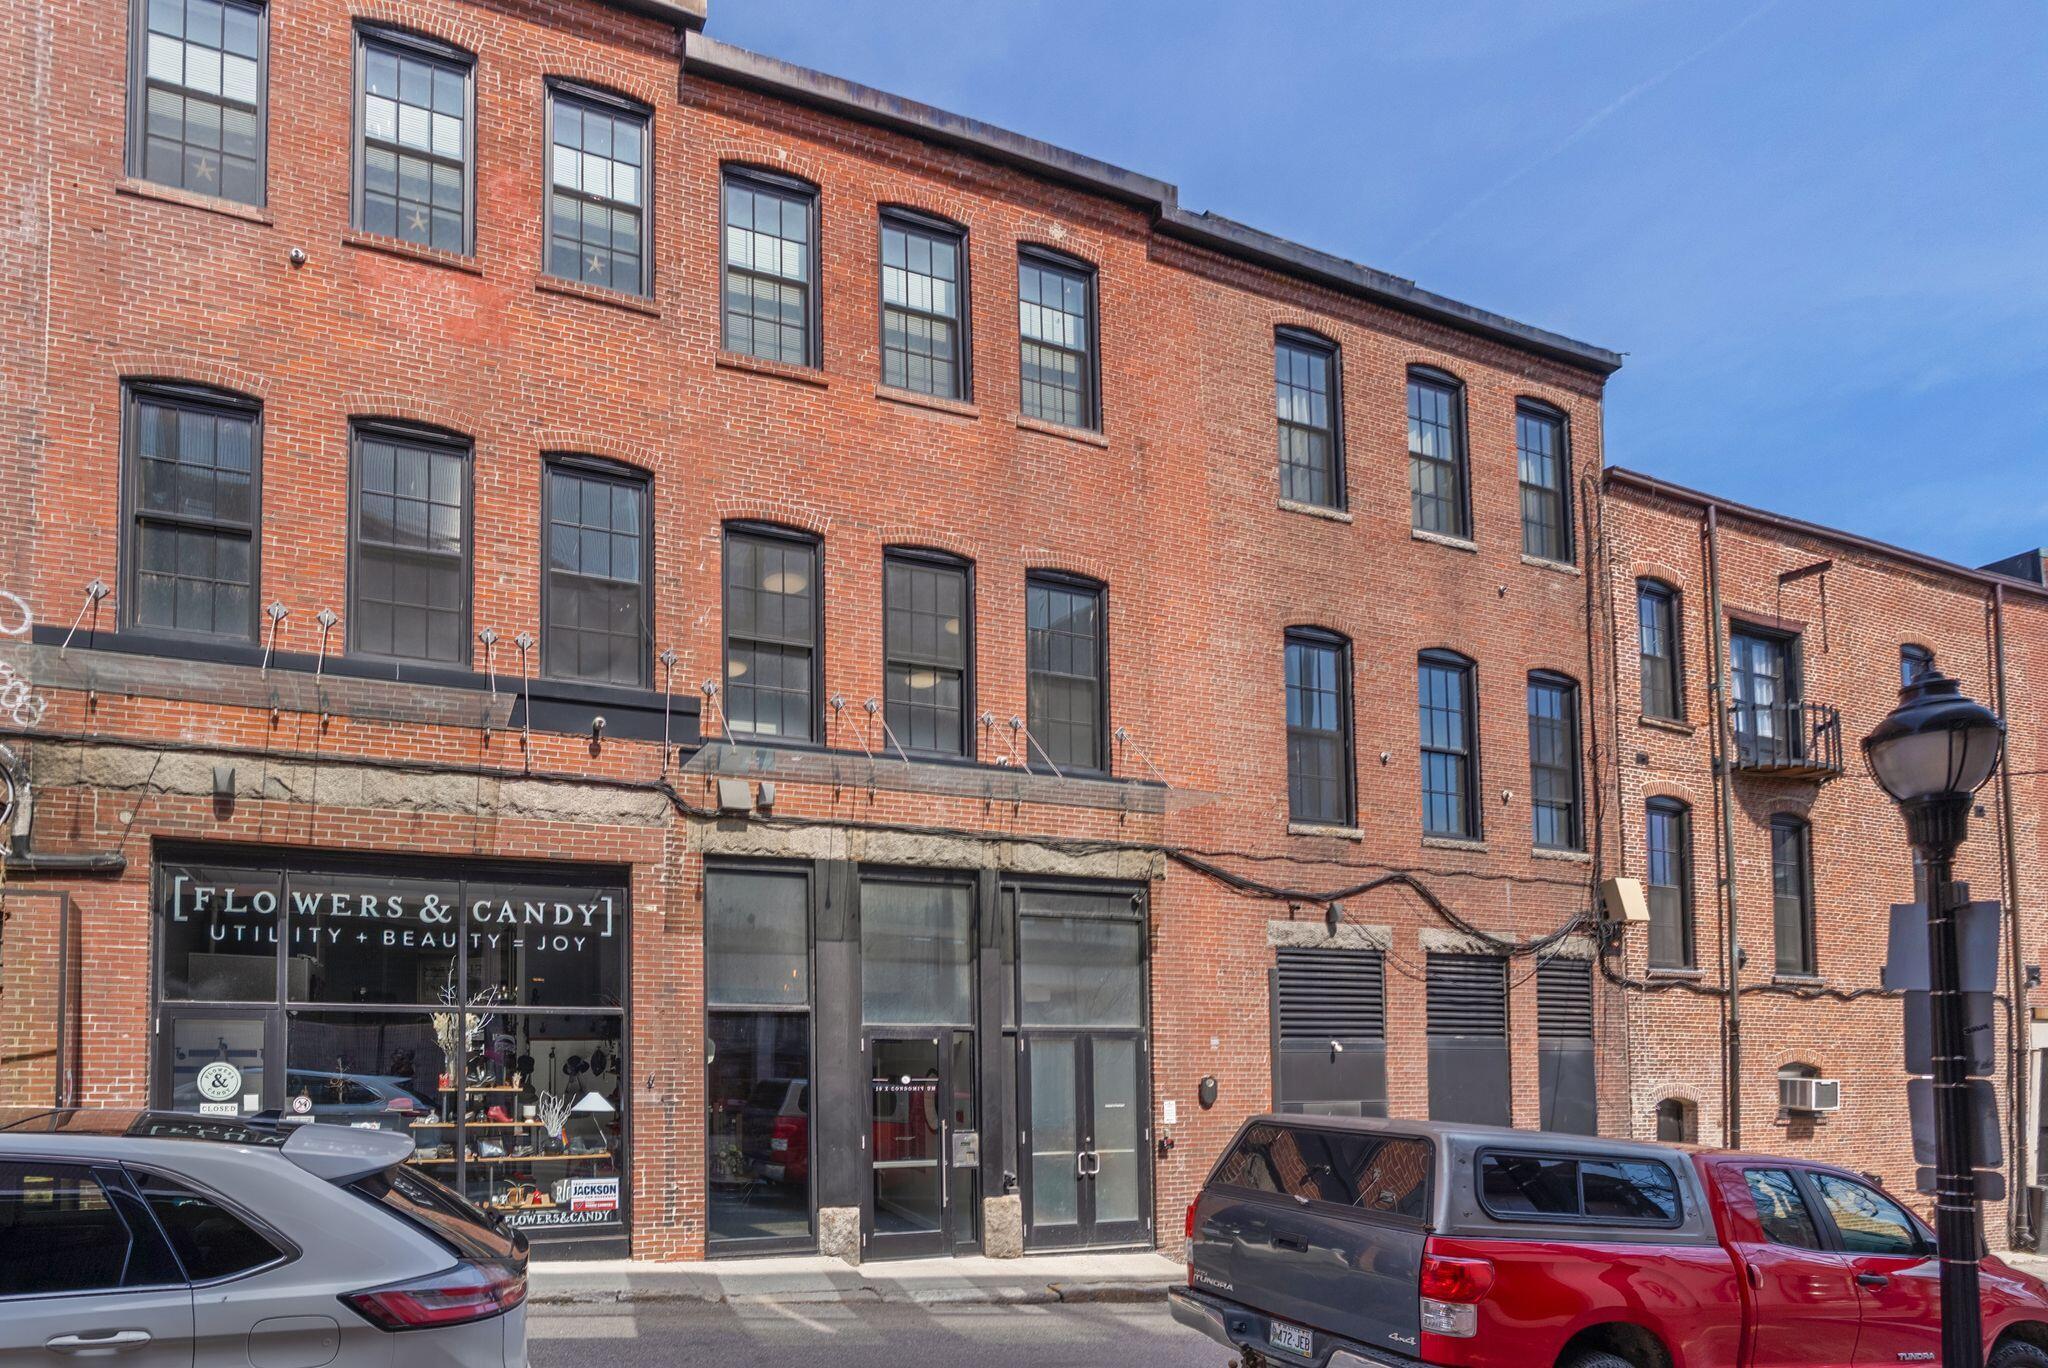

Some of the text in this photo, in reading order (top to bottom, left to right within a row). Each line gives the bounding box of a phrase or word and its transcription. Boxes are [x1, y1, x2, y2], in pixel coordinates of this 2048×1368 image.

[419, 895, 452, 925] &
[210, 924, 341, 945] UTILITY
[383, 930, 499, 949] BEAUTY
[537, 935, 586, 952] JOY
[212, 1074, 228, 1088] &
[573, 1184, 617, 1196] JACKSON
[1194, 1274, 1234, 1291] TUNDRA
[1896, 1352, 1935, 1360] TUNDRA
